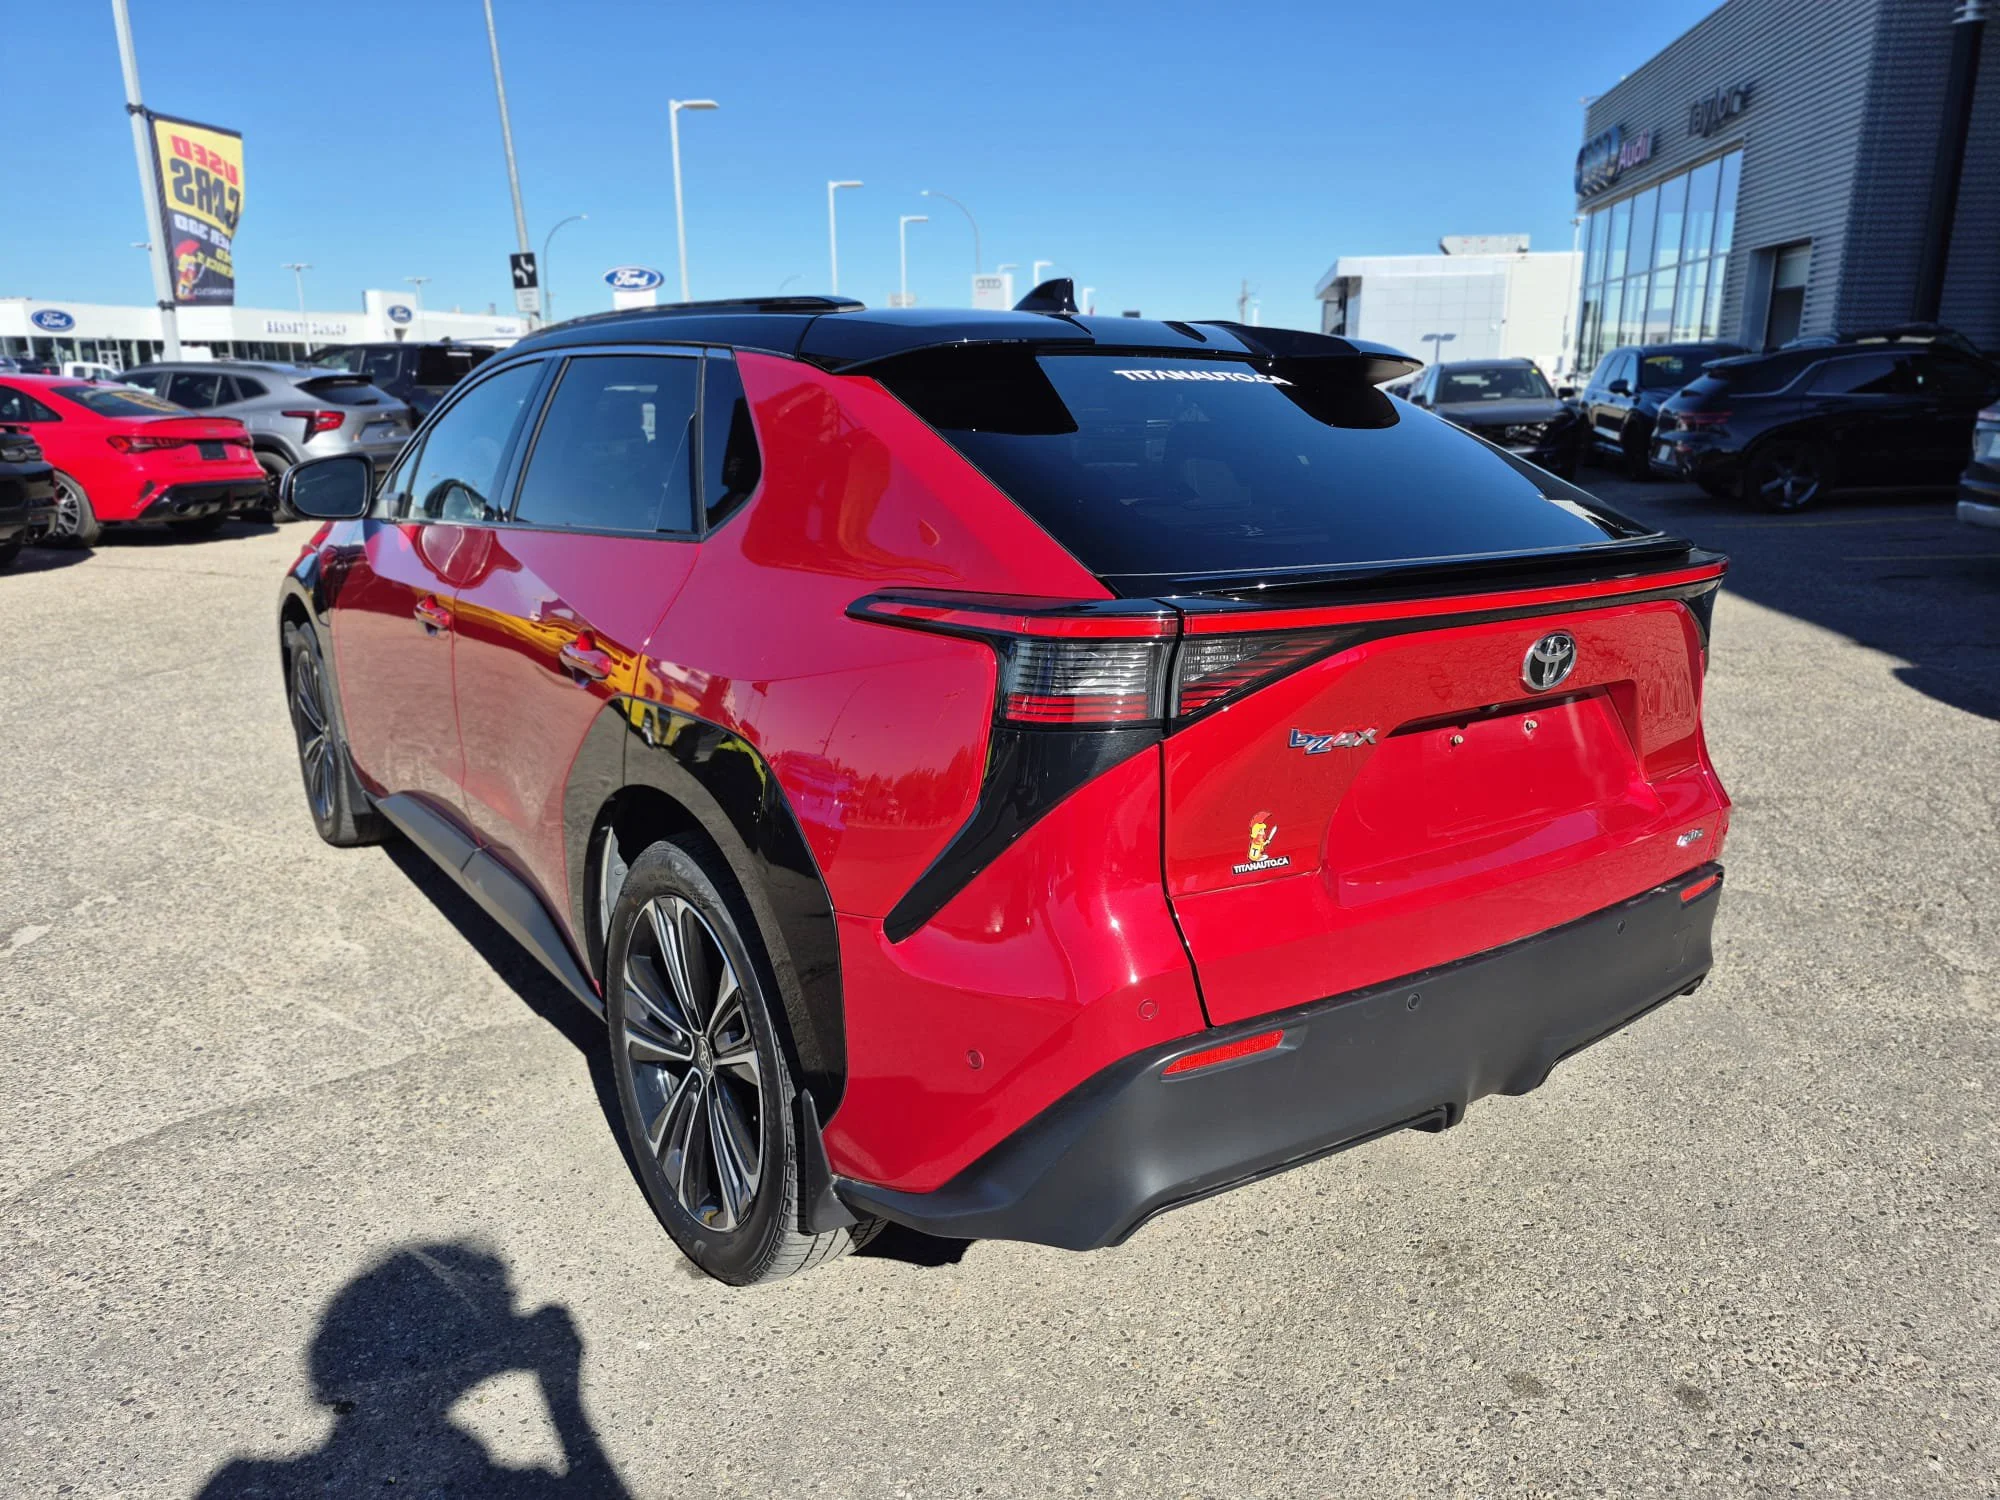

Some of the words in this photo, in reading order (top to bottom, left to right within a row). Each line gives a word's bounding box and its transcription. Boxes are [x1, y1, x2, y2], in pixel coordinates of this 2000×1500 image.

[1616, 127, 1652, 174] Audi
[613, 270, 649, 285] Ford
[1233, 857, 1289, 874] TITANAUTO.CA
